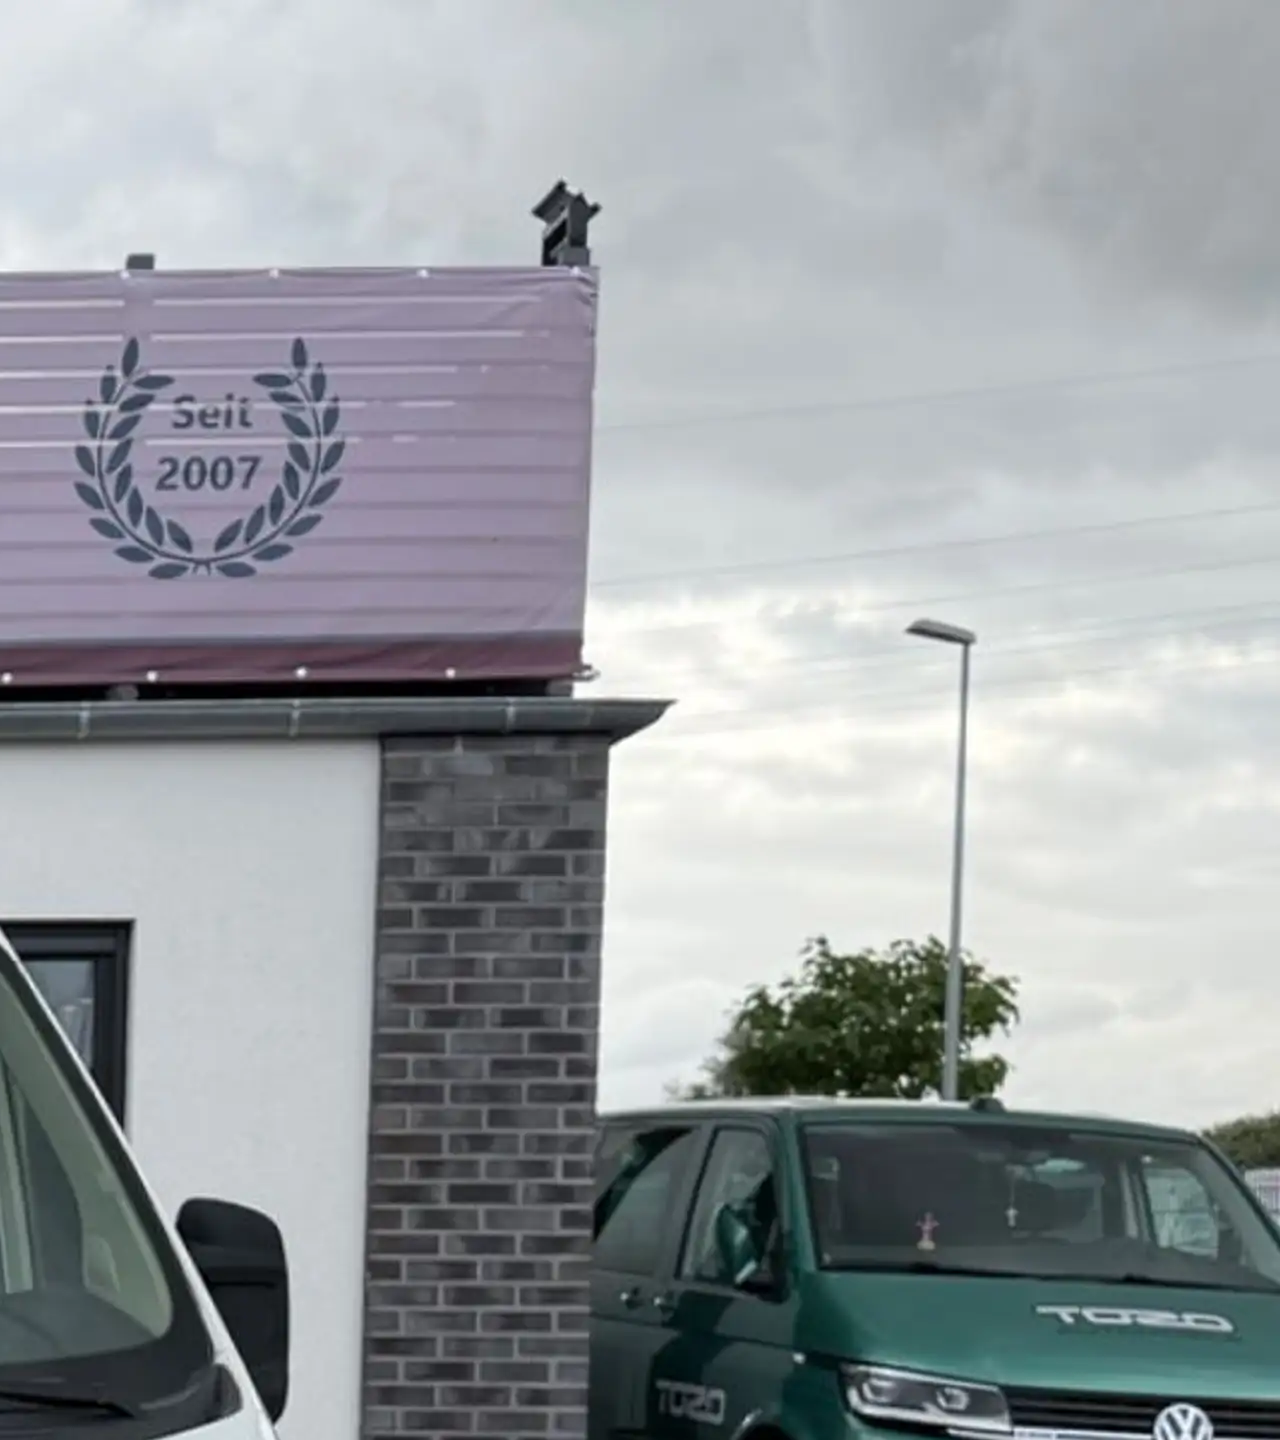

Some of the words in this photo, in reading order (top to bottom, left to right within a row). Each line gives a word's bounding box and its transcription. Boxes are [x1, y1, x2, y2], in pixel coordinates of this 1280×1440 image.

[171, 393, 254, 429] Seit
[154, 455, 262, 491] 2007
[1037, 1305, 1234, 1332] TOZO
